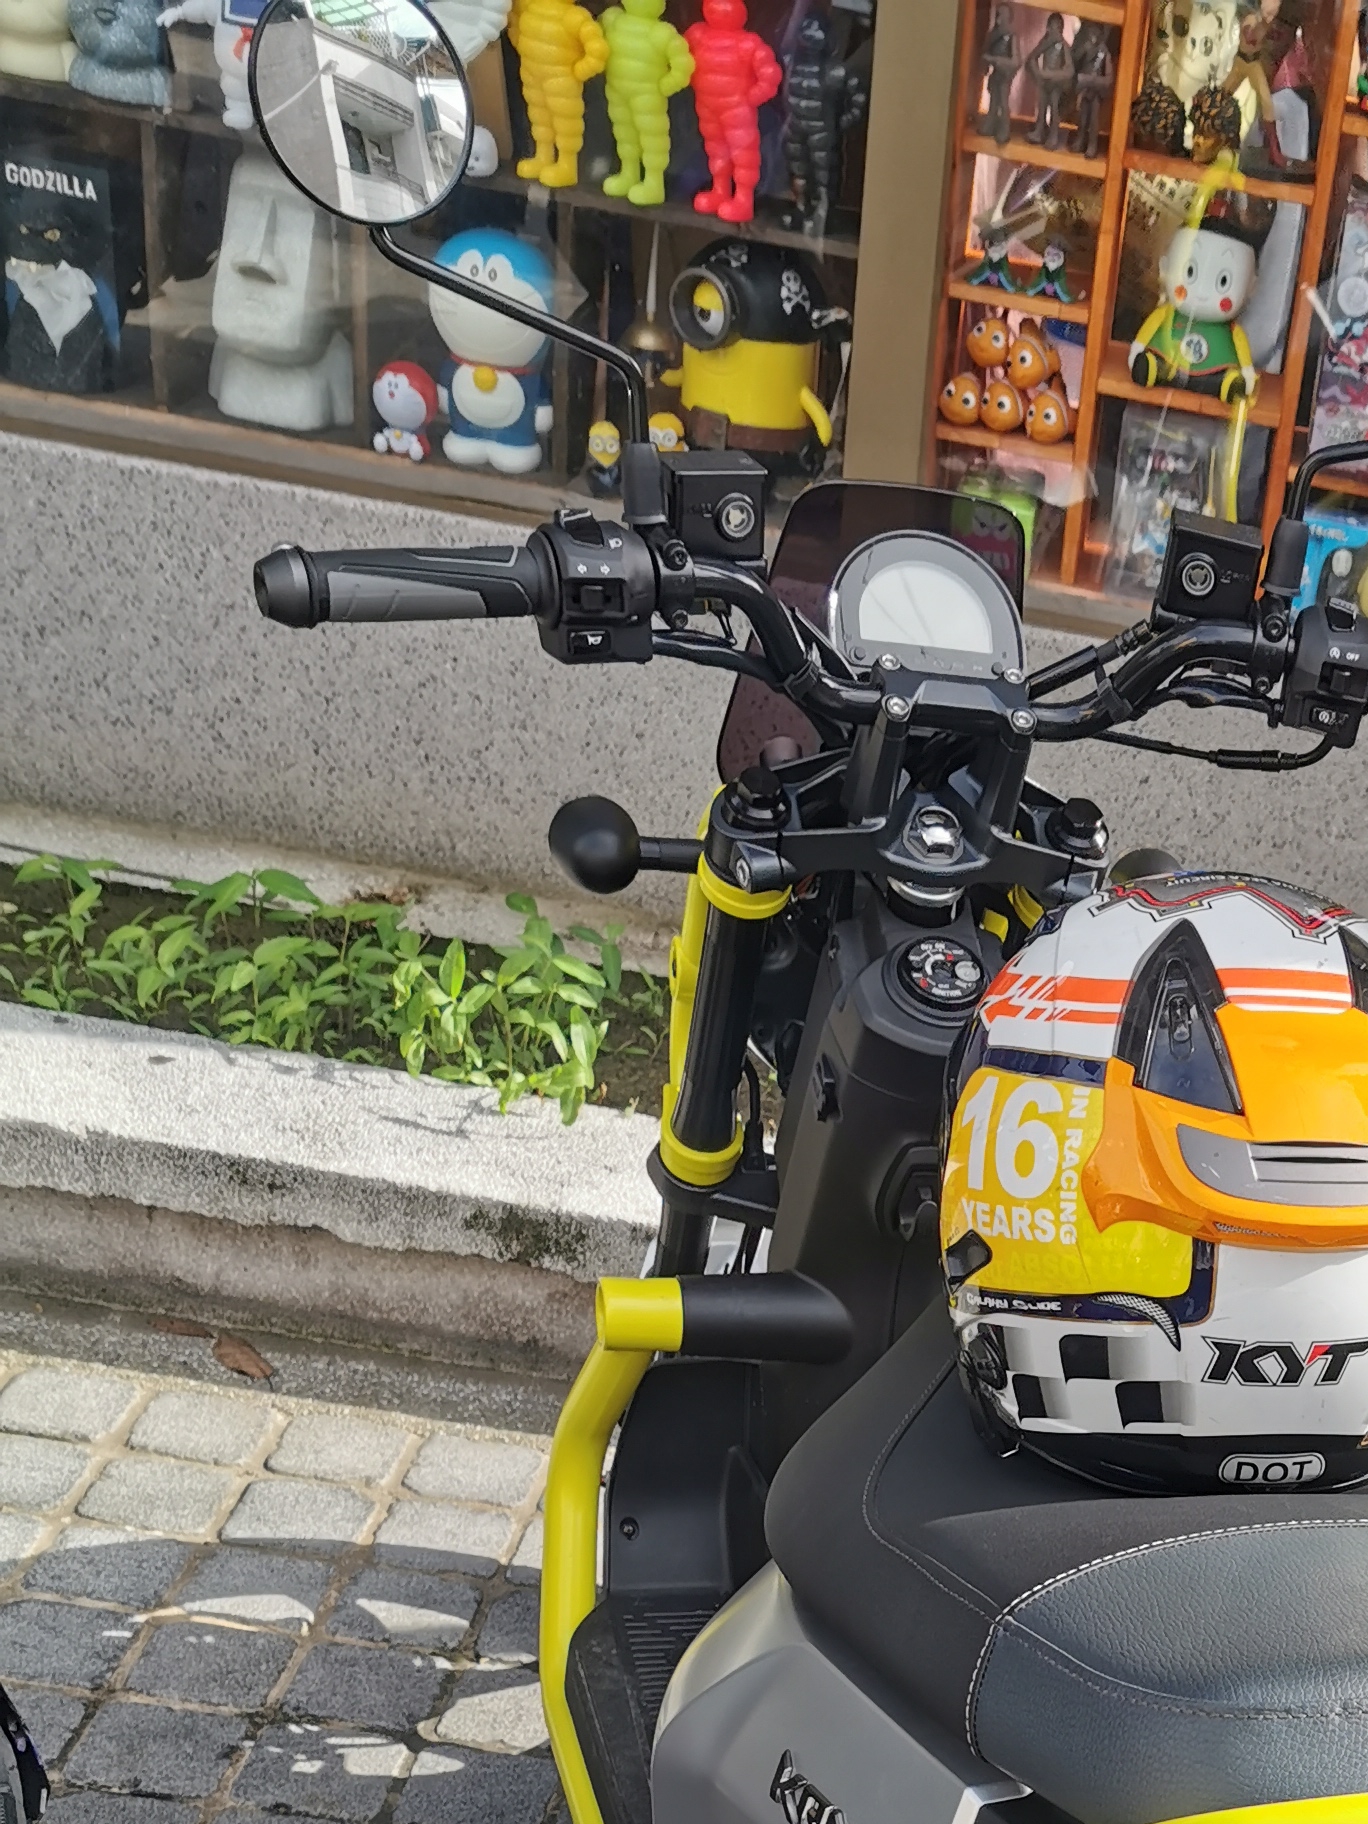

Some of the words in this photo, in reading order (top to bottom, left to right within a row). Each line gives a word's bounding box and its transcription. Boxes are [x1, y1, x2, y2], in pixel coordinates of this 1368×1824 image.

[5, 162, 98, 202] GODZILLA
[1068, 1086, 1091, 1120] IN
[961, 1076, 1064, 1200] 16
[1059, 1128, 1084, 1246] RACING
[961, 1197, 1056, 1244] YEARS
[1233, 1459, 1313, 1483] DOT
